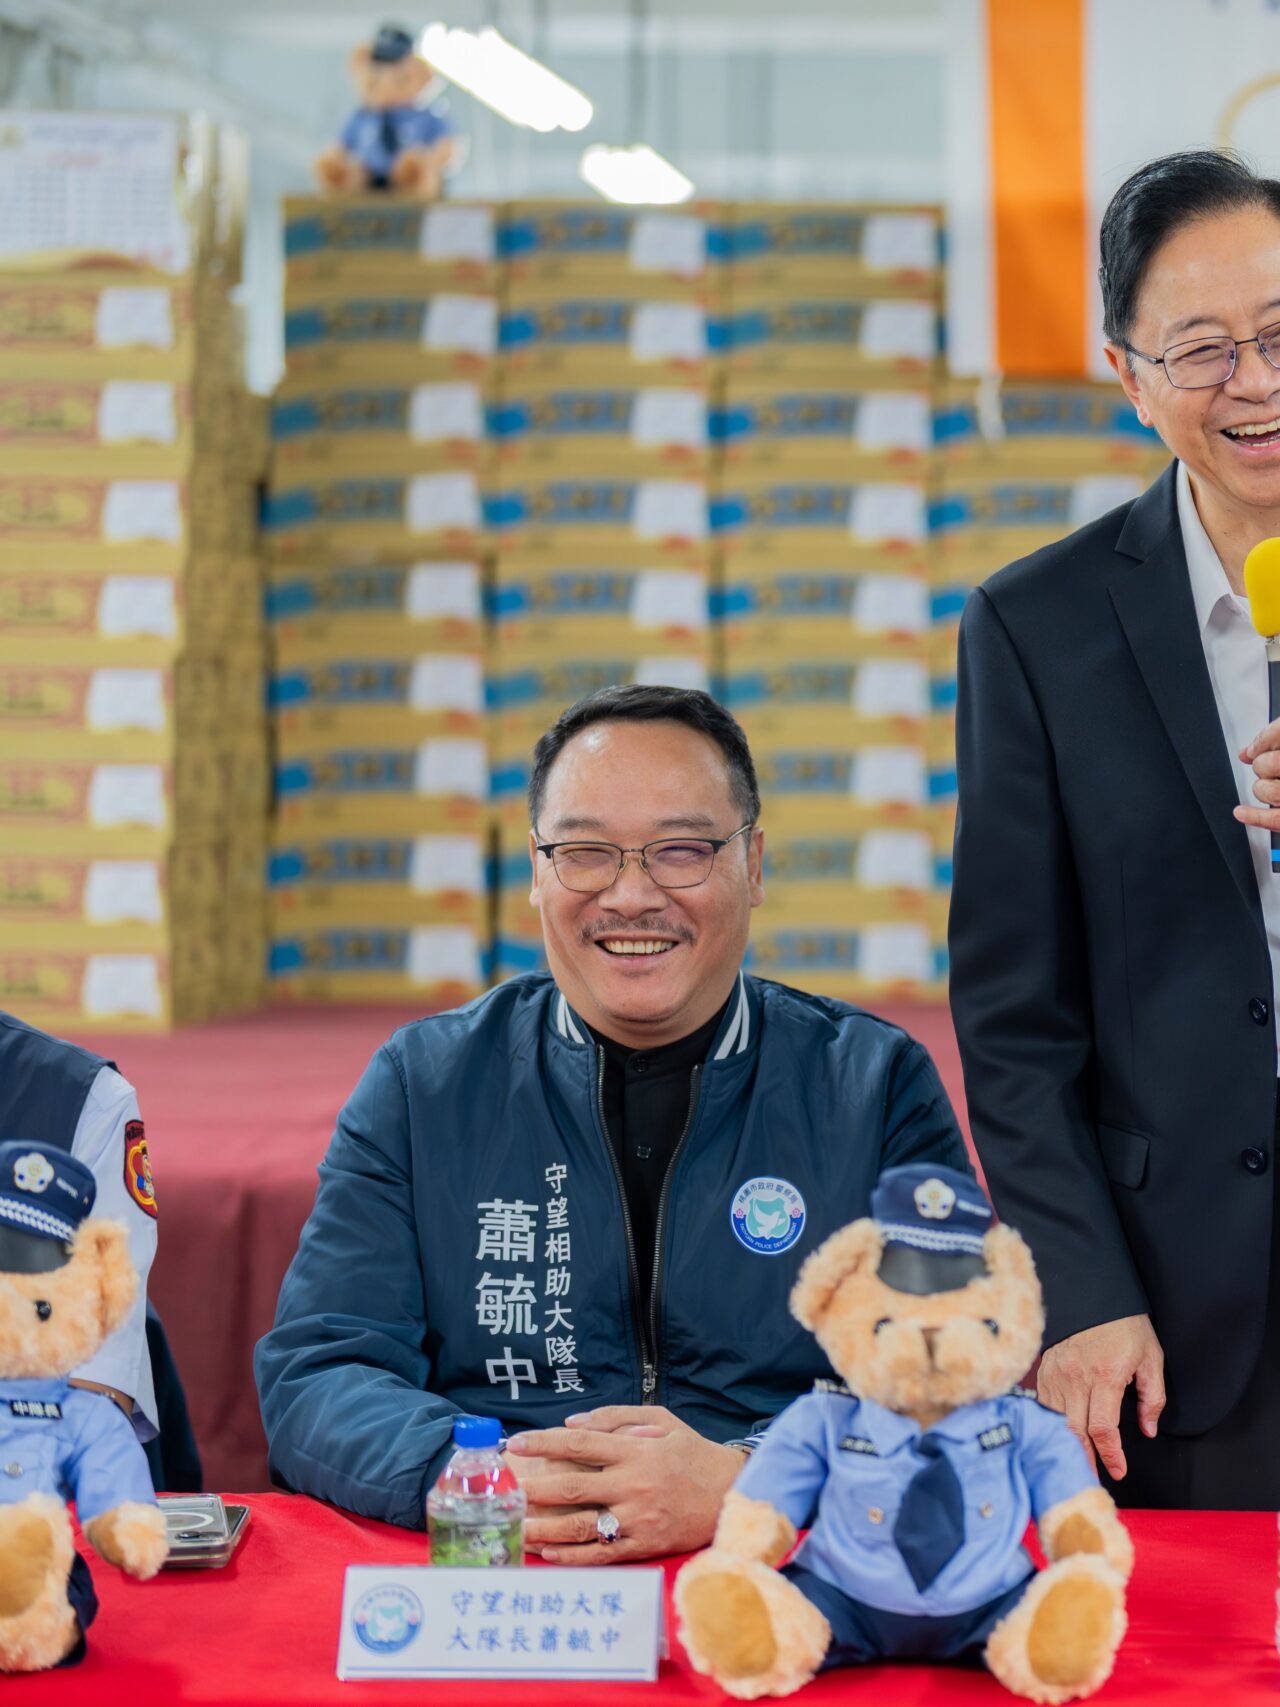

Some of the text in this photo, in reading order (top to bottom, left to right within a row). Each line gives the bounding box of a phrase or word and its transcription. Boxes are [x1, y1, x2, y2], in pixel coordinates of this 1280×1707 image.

[475, 1198, 539, 1400] 蕭毓中
[544, 1162, 585, 1394] 守望相助大隊長
[448, 1626, 621, 1653] 大隊長蕭毓中
[451, 1591, 625, 1617] 守望相助大隊
